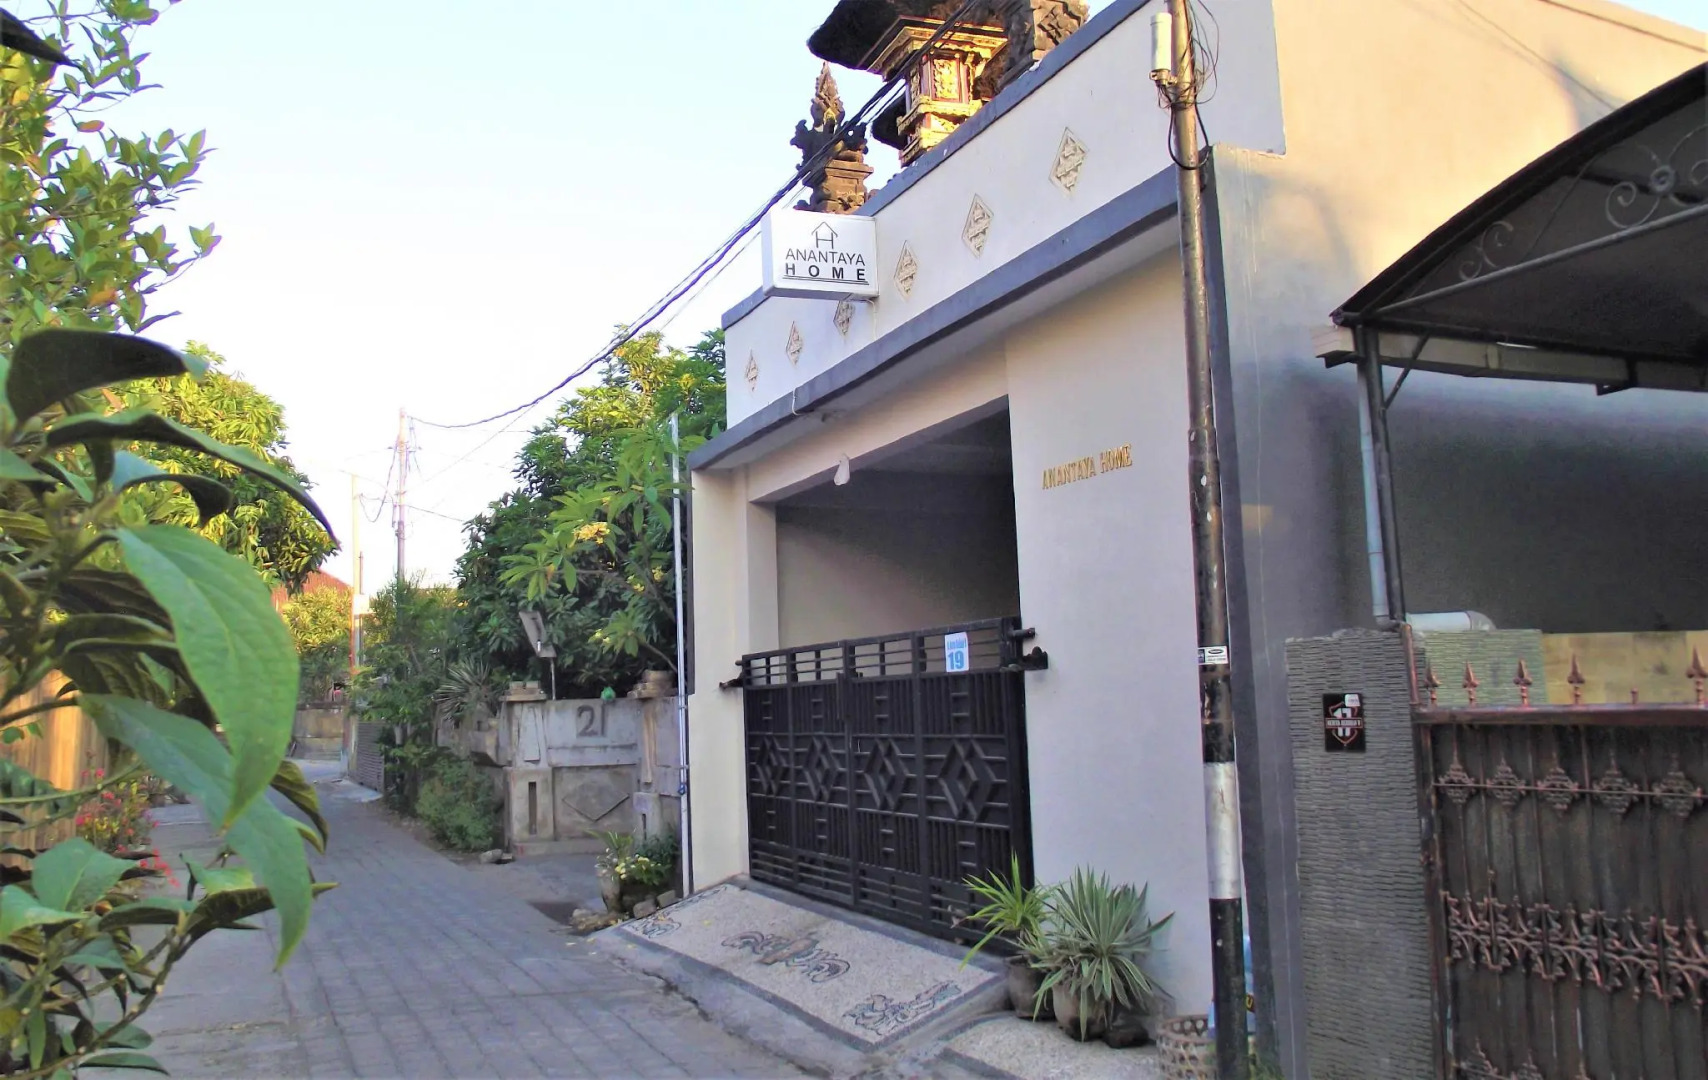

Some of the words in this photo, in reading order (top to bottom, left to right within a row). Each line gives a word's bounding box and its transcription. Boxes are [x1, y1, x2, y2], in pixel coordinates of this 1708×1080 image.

[785, 248, 866, 267] ANANTAYA
[785, 262, 866, 281] HOME
[1042, 456, 1097, 490] ANANTAYA
[1100, 442, 1133, 474] HOME
[948, 650, 965, 670] 19
